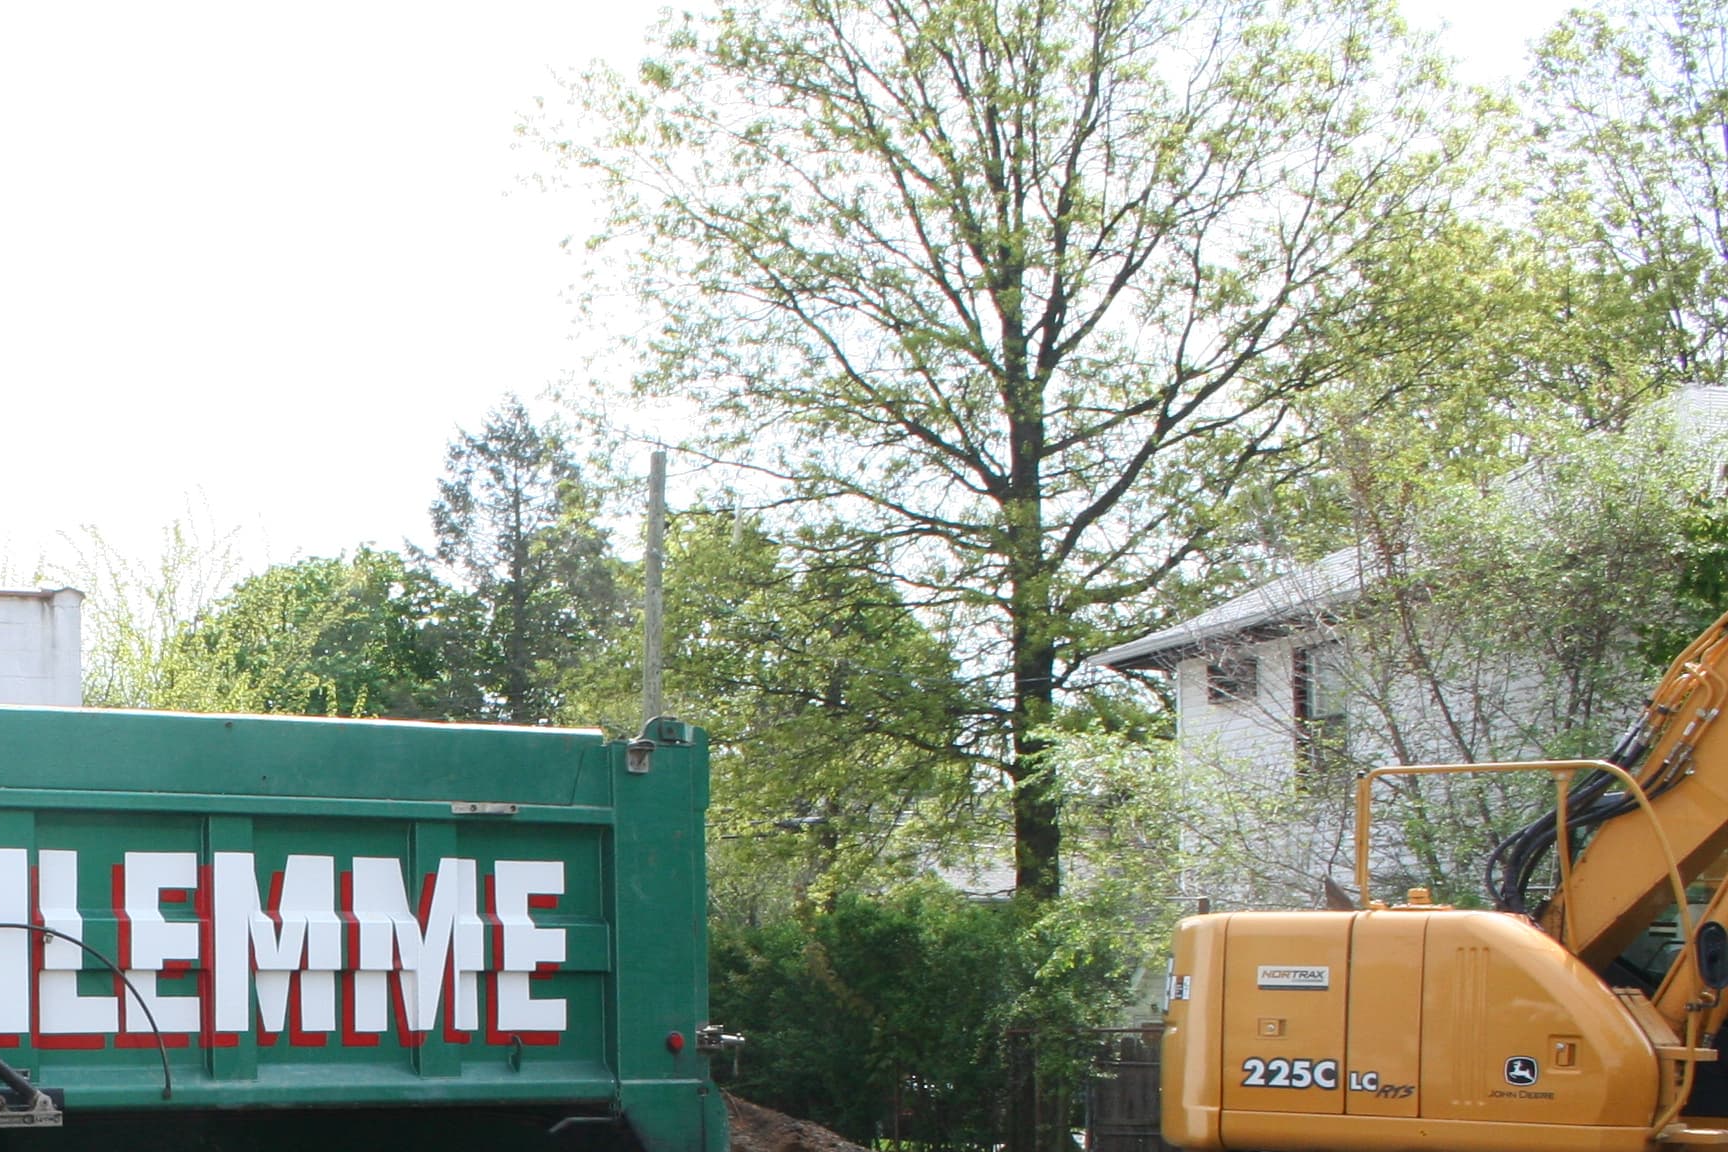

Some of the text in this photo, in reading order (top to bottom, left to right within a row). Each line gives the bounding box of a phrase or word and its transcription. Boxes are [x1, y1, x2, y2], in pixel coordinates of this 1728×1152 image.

[1262, 970, 1325, 979] NORTRAX
[1241, 1057, 1338, 1089] 225C
[1349, 1071, 1378, 1092] LC
[1487, 1090, 1555, 1100] JOHN DEERE
